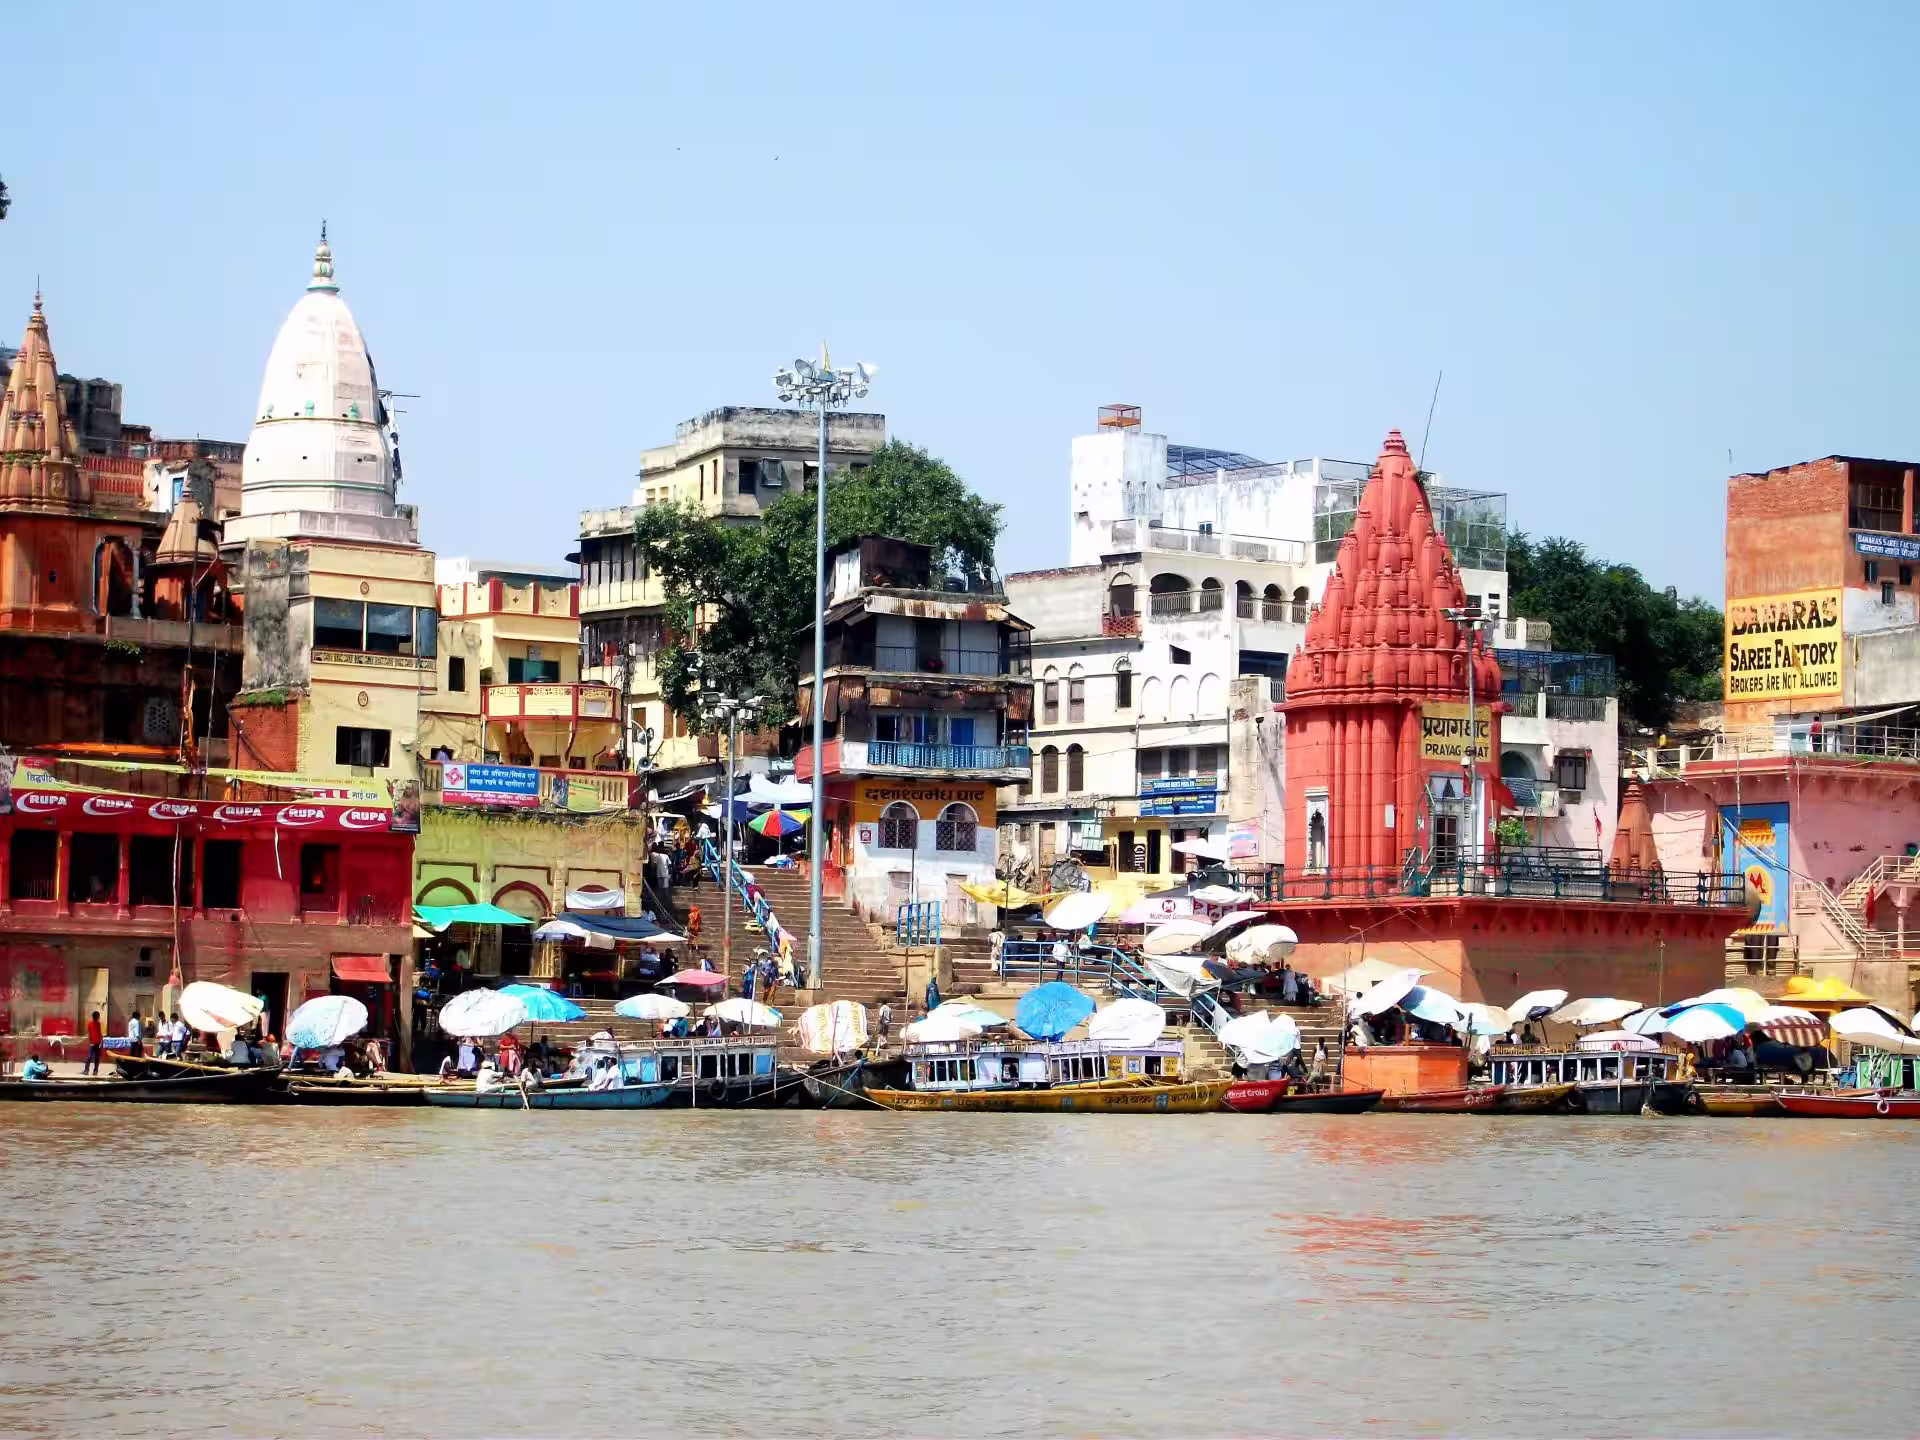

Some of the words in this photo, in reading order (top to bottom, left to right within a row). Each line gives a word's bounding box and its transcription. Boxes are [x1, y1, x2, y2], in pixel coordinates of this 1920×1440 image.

[1900, 541, 1920, 551] FACTOR
[1730, 643, 1772, 672] SAREE
[1731, 676, 1763, 694] BROKERS
[1766, 673, 1780, 691] ARE
[1782, 671, 1797, 690] NOT
[1800, 671, 1838, 688] ALLOWED
[1422, 717, 1465, 738] प्रयाग
[1425, 743, 1462, 756] PRAYAG
[29, 794, 68, 806] RUPA
[956, 788, 986, 800] घाट
[96, 799, 133, 809] RUPA
[225, 806, 262, 817] RUPA
[289, 808, 325, 819] RUPA
[351, 811, 387, 822] RUPA
[1221, 1090, 1247, 1100] uthoot
[1247, 1088, 1270, 1098] Group
